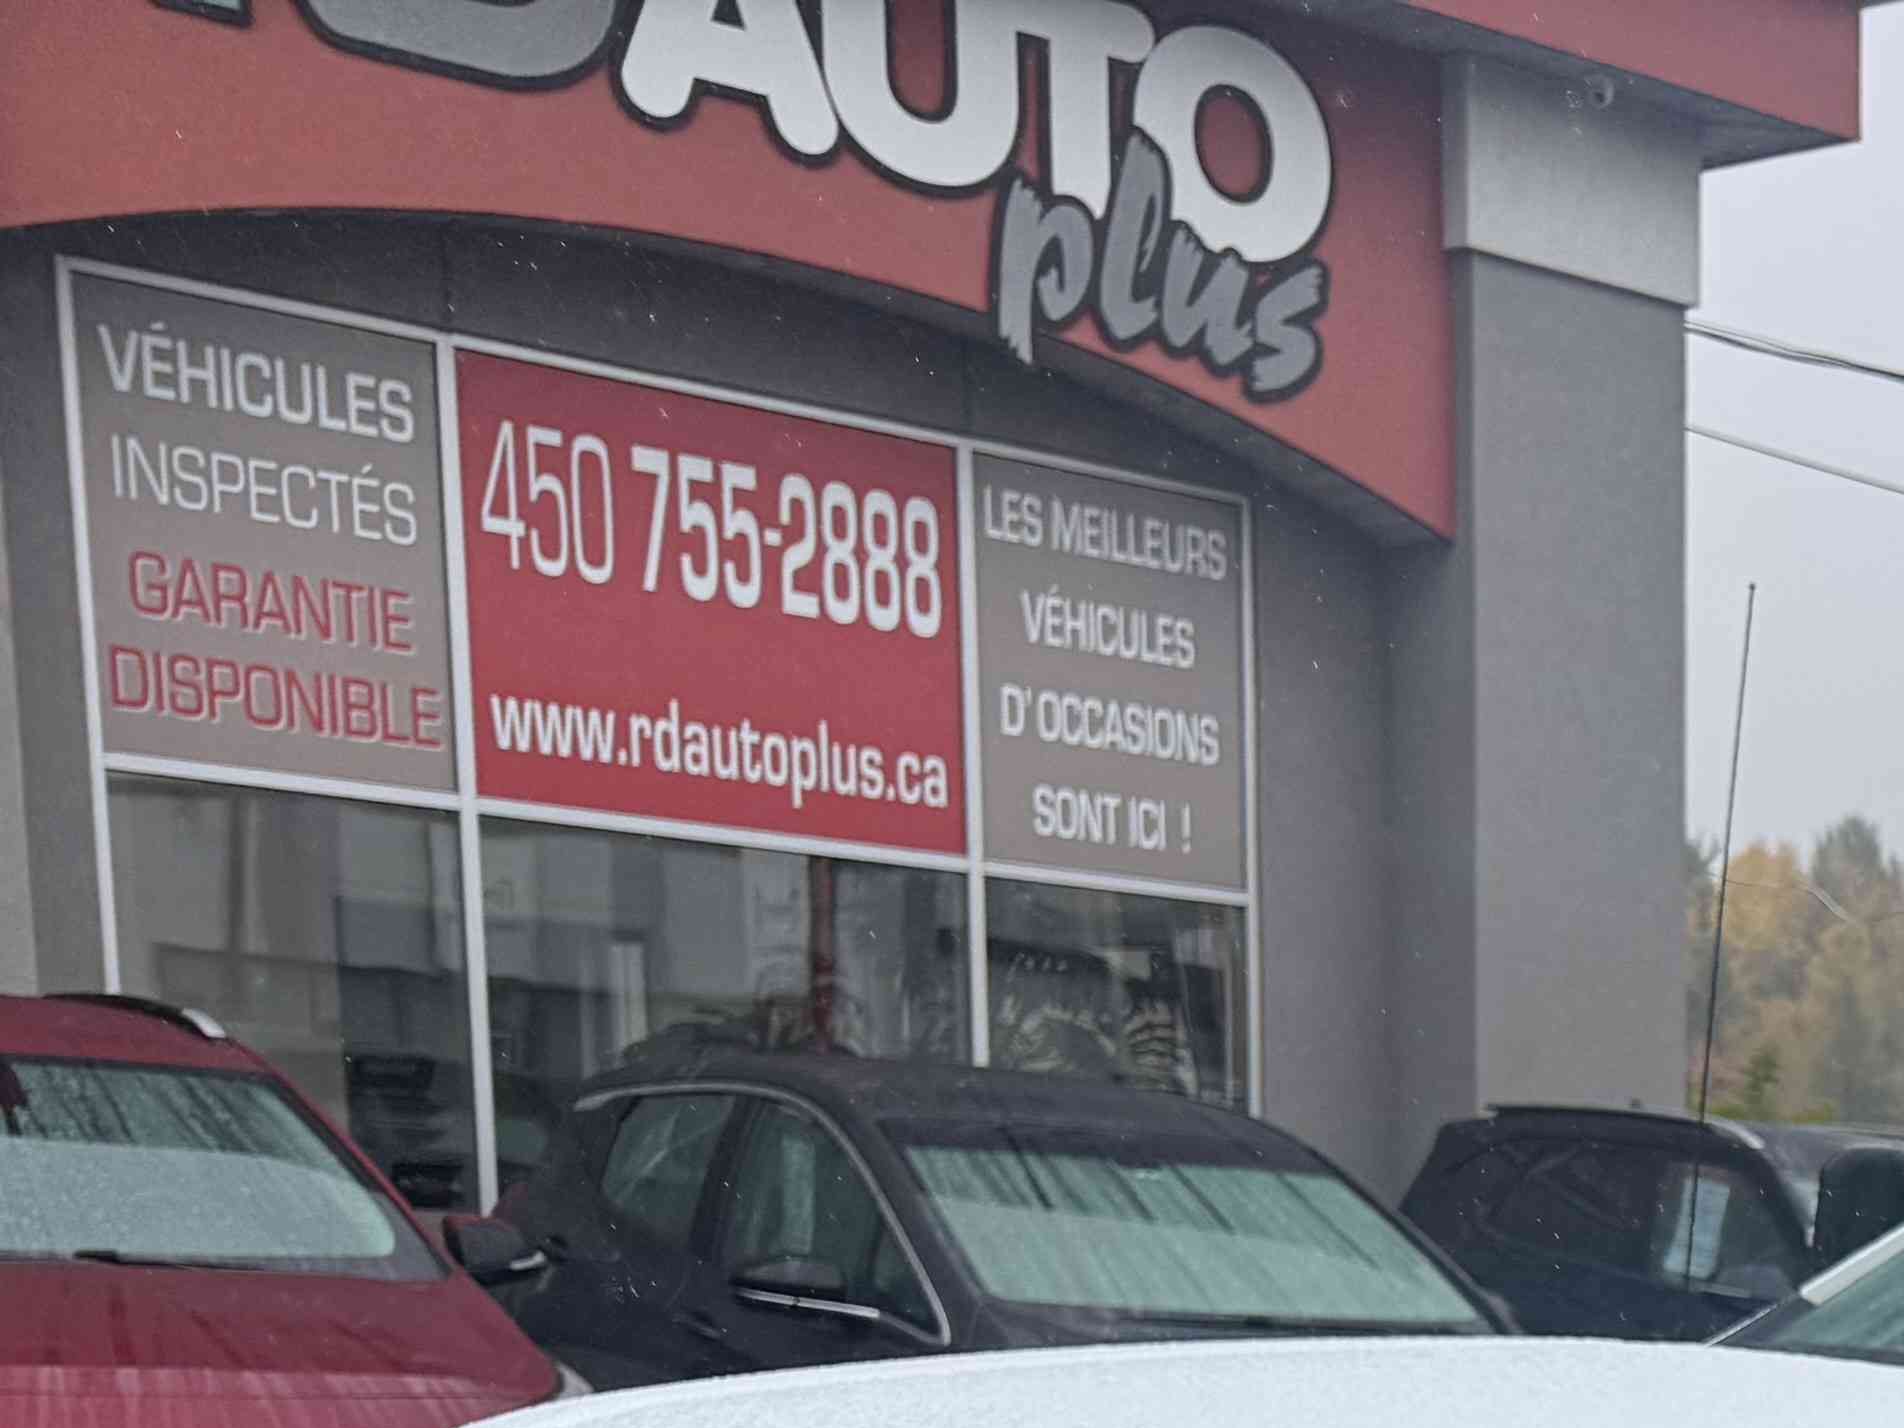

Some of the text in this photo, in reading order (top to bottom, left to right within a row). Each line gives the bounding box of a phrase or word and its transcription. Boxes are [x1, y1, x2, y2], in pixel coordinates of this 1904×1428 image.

[999, 132, 1325, 394] plus
[97, 321, 414, 443] VÉHICULES
[110, 433, 418, 547] INSPECTÉS
[481, 419, 942, 639] 450 755-2888
[983, 484, 1228, 581] LES MEILLEURS
[128, 550, 417, 655] GARANTIE
[1019, 583, 1196, 669] VÉHICULES
[107, 642, 445, 751] DISPONIBLE
[489, 693, 950, 810] www.rdautoplus.ca
[1032, 783, 1121, 845] SONT
[1128, 796, 1168, 852] ICI
